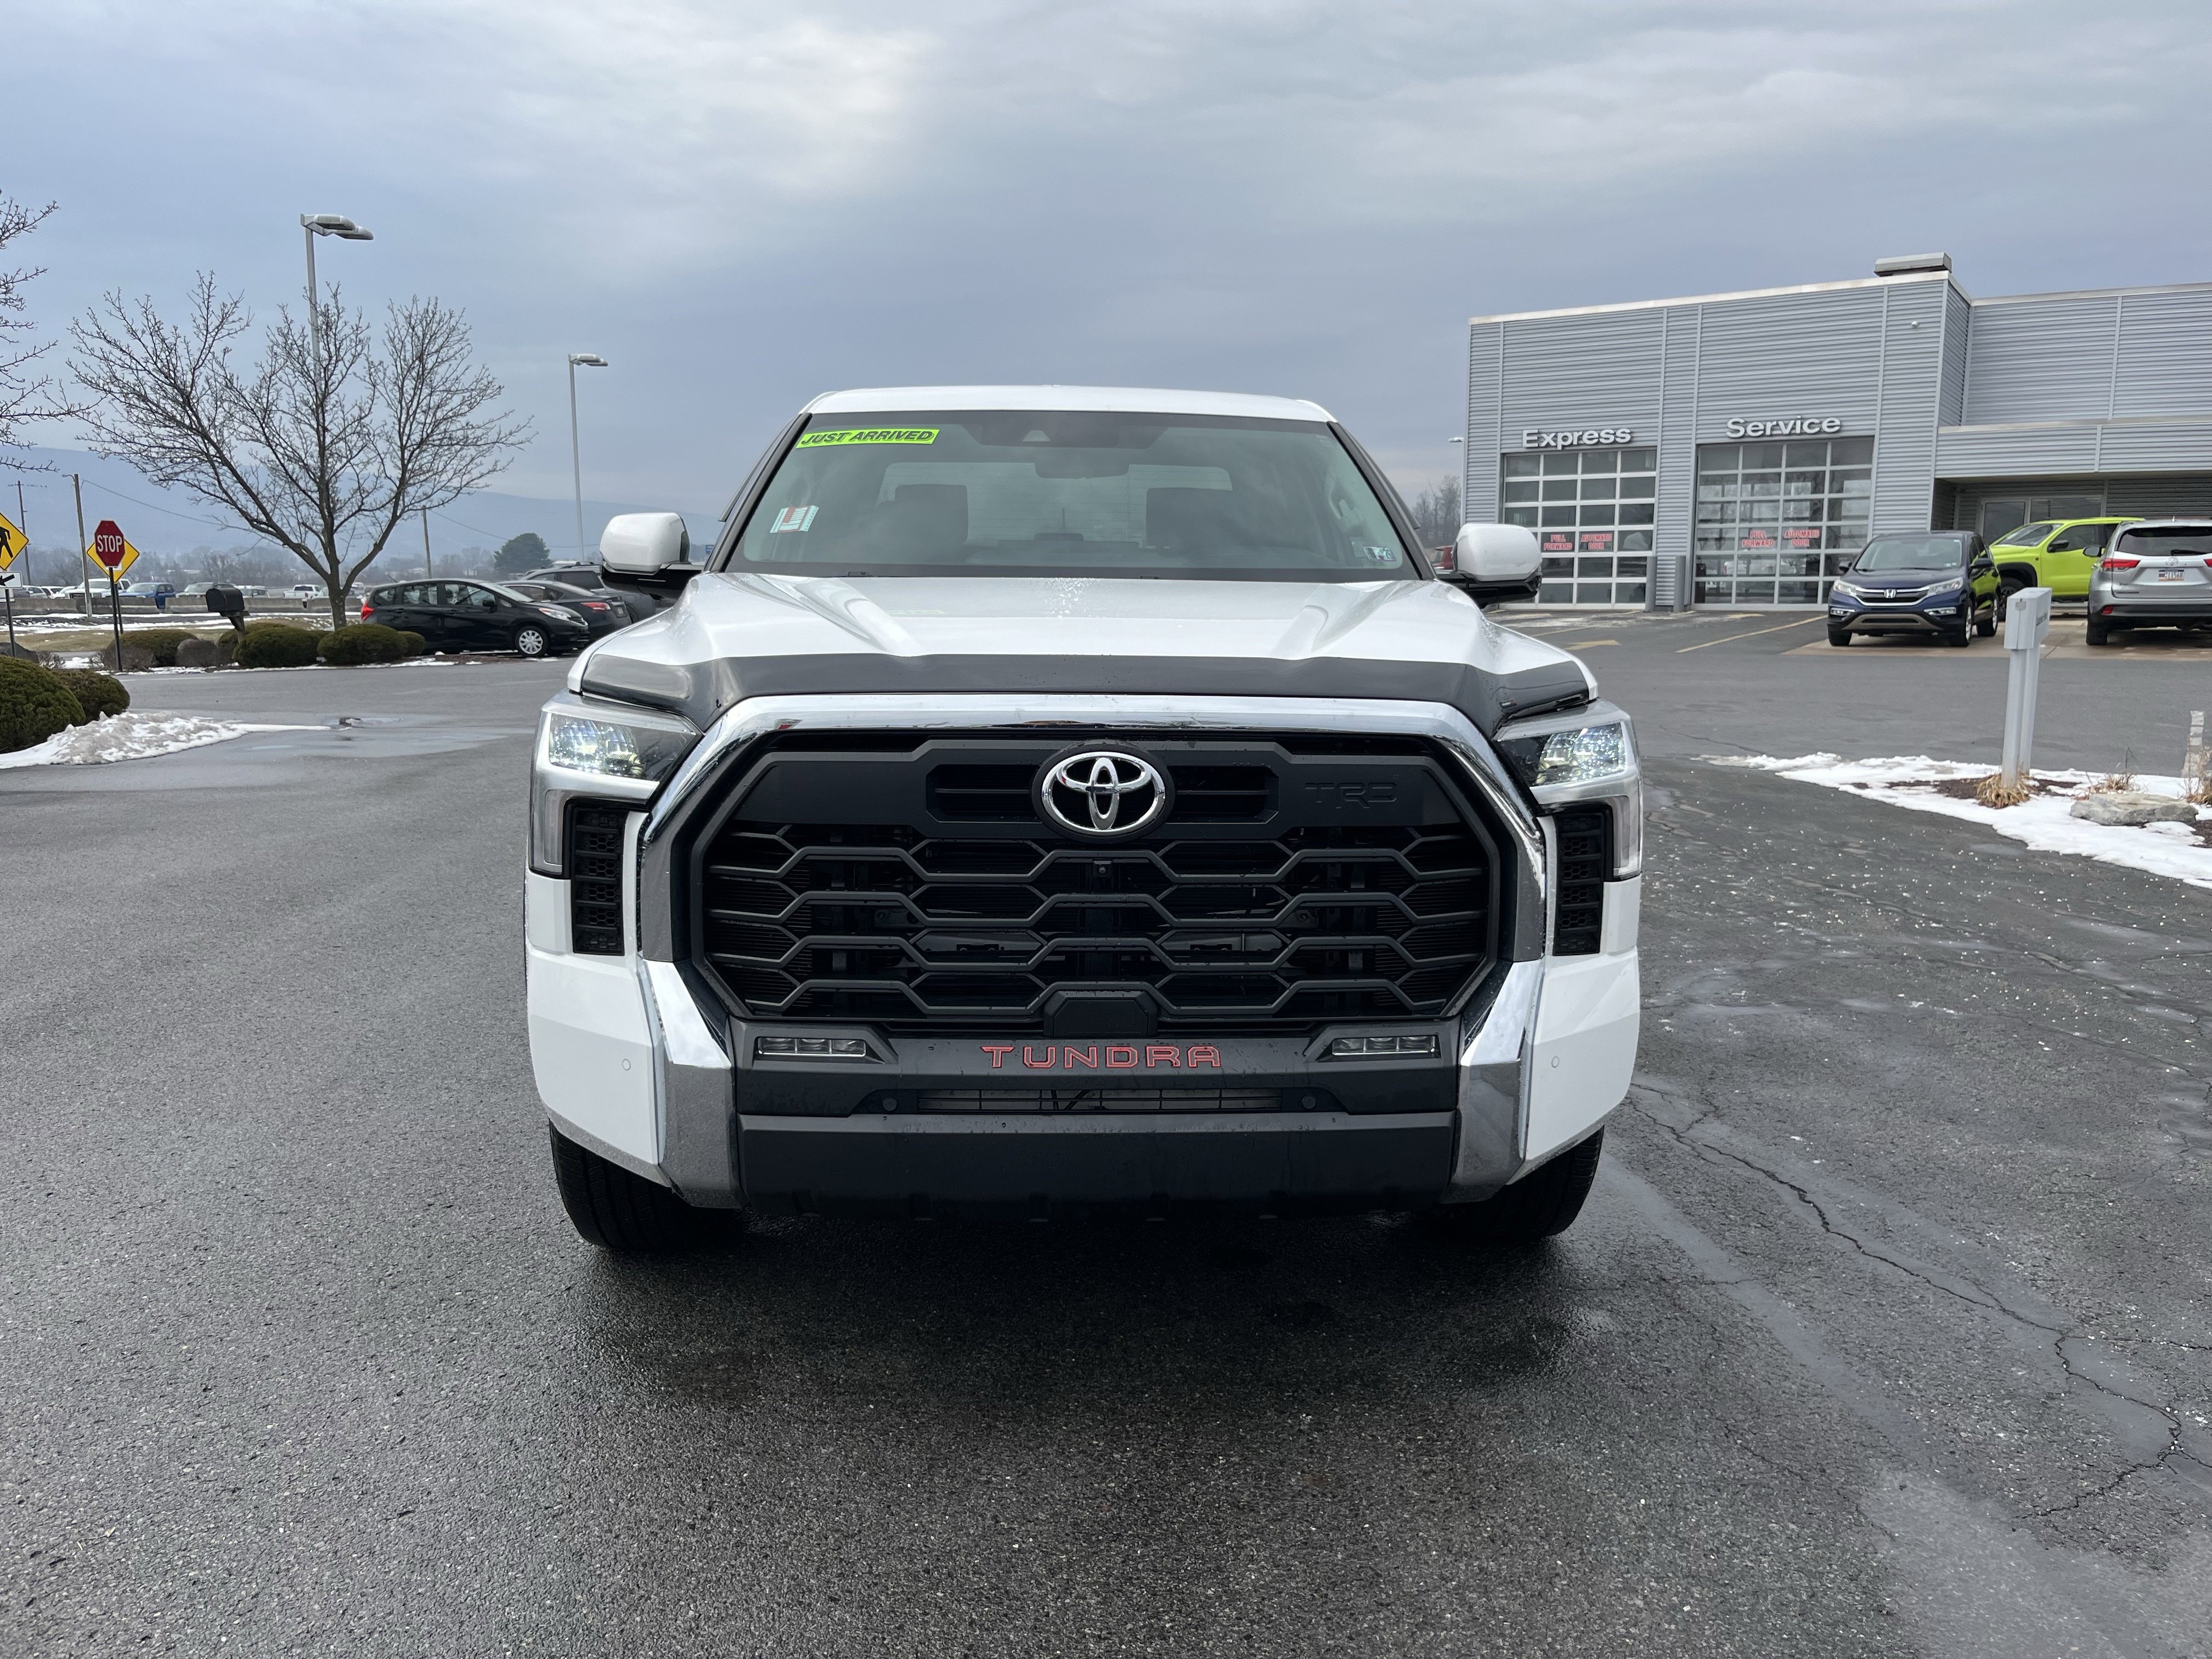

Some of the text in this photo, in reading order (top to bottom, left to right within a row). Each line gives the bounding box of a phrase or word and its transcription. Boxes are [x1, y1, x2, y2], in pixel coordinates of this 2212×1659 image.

[1726, 415, 1841, 438] Service
[801, 431, 934, 445] JUST ARRIVED
[1522, 428, 1632, 450] Express
[1581, 534, 1612, 542] AUTOMATIC
[1784, 529, 1820, 538] AUTOMATIC
[97, 535, 122, 552] STOP
[1742, 539, 1774, 548] FORWARD
[1791, 539, 1809, 547] DOOR
[1305, 782, 1397, 809] TRD
[980, 1045, 1221, 1069] TUNDRA
